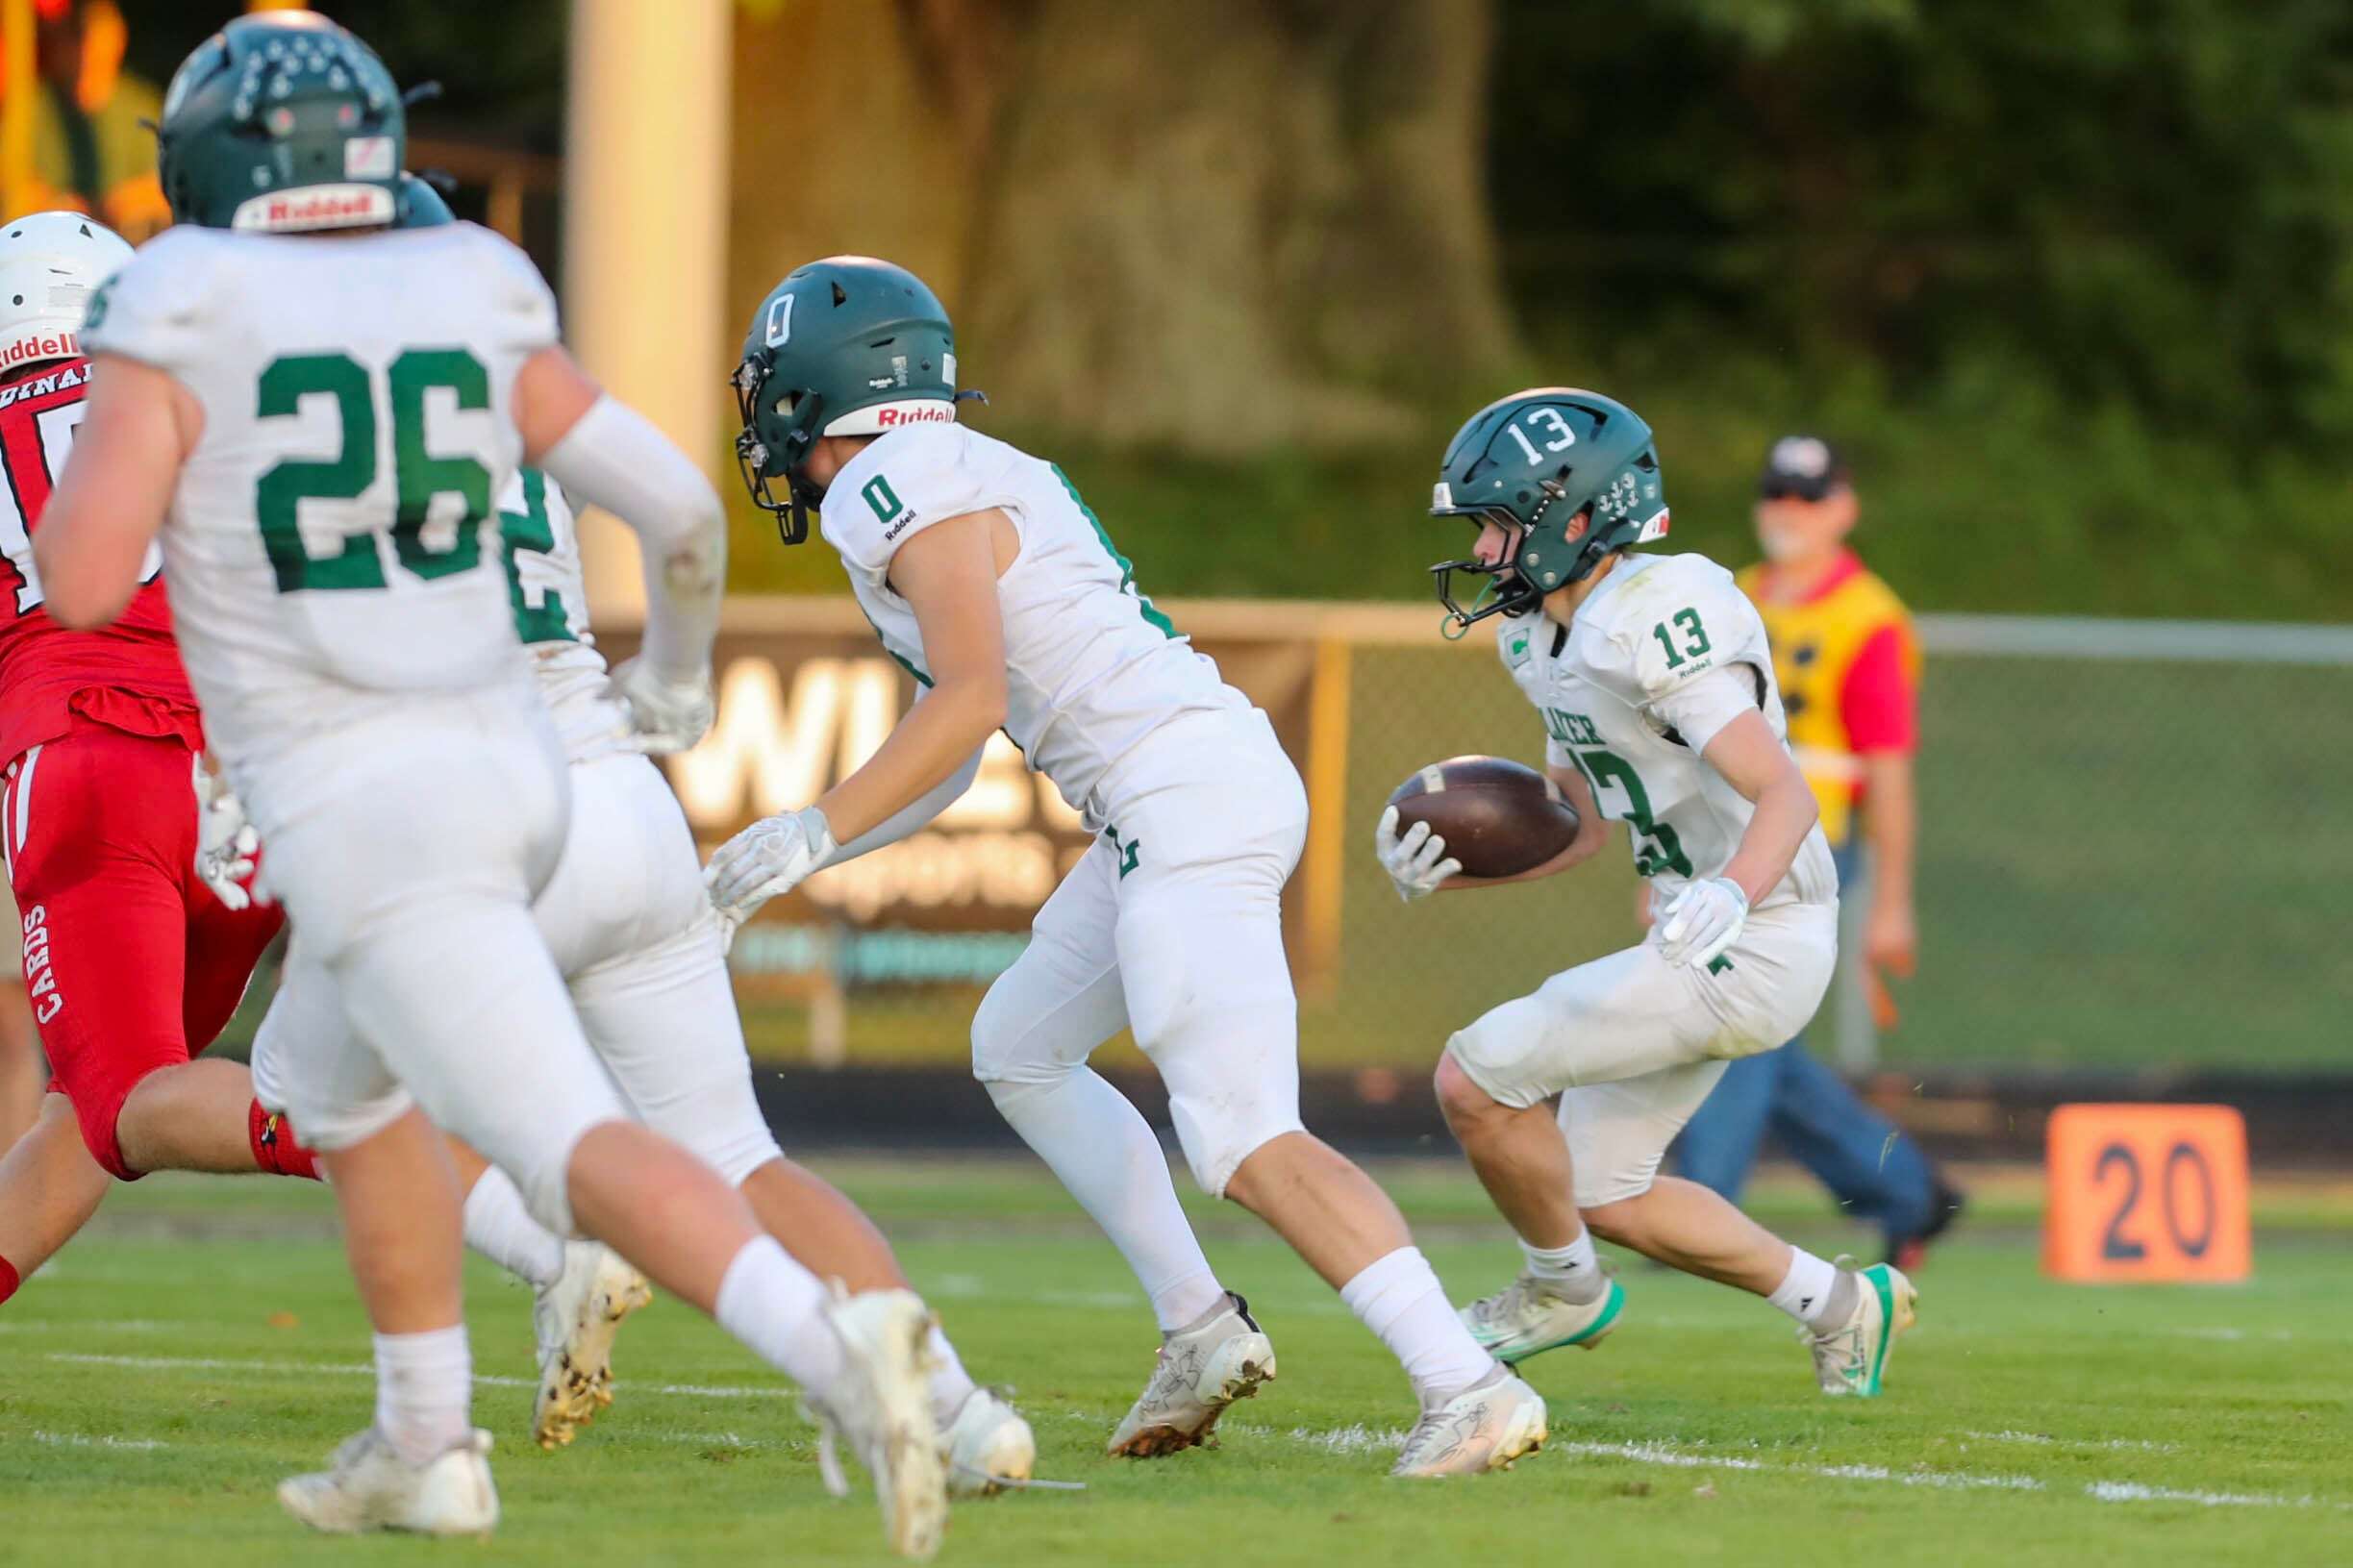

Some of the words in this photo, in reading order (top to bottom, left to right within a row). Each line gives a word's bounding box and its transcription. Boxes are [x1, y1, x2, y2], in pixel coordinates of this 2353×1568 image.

[0, 333, 79, 368] iddell
[1507, 408, 1577, 466] 13
[256, 347, 492, 594] 26
[861, 474, 904, 524] 0
[884, 509, 917, 541] Riddell
[1652, 607, 1711, 670] 13
[23, 904, 63, 1025] CARDS
[2092, 1142, 2217, 1259] 20
